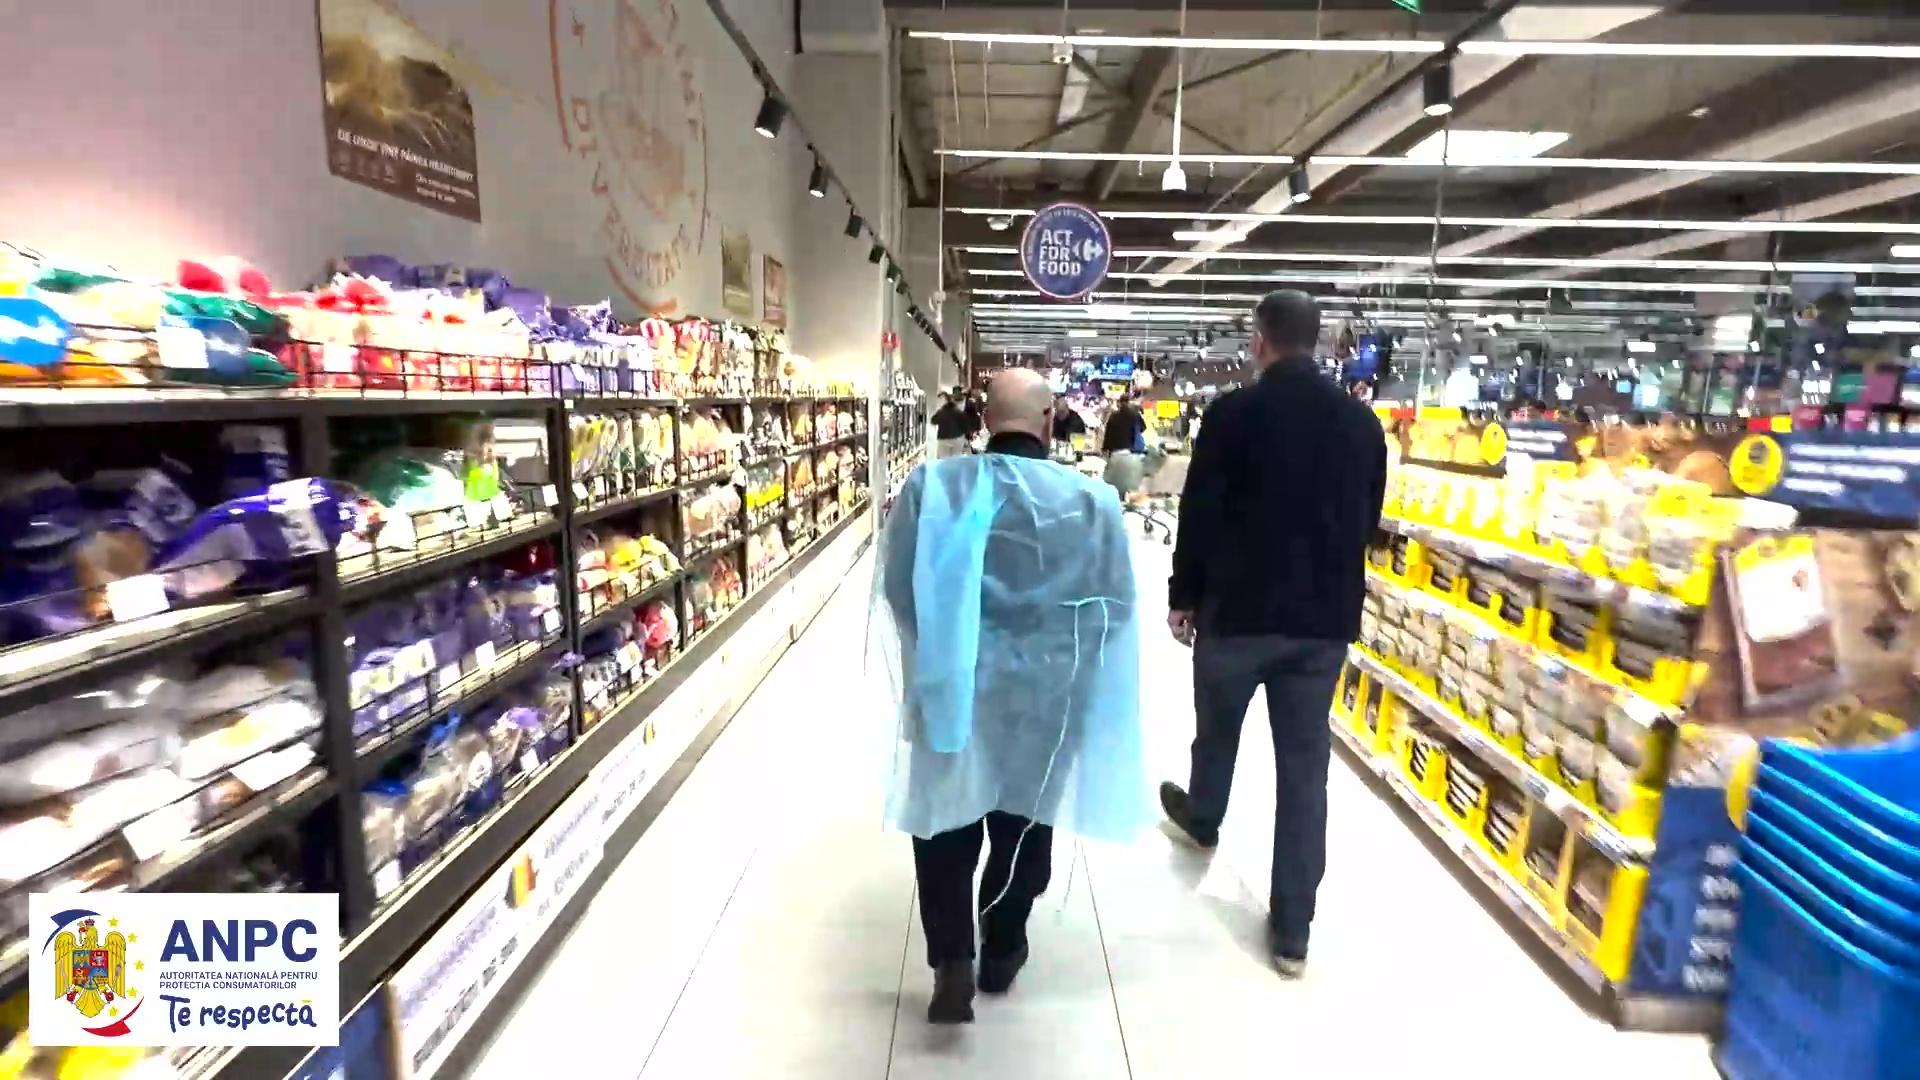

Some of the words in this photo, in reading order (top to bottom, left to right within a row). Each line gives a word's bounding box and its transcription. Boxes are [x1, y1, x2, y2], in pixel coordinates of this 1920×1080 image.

[1041, 228, 1073, 246] ACT
[1040, 245, 1071, 261] FOR
[1039, 260, 1081, 275] FOOD
